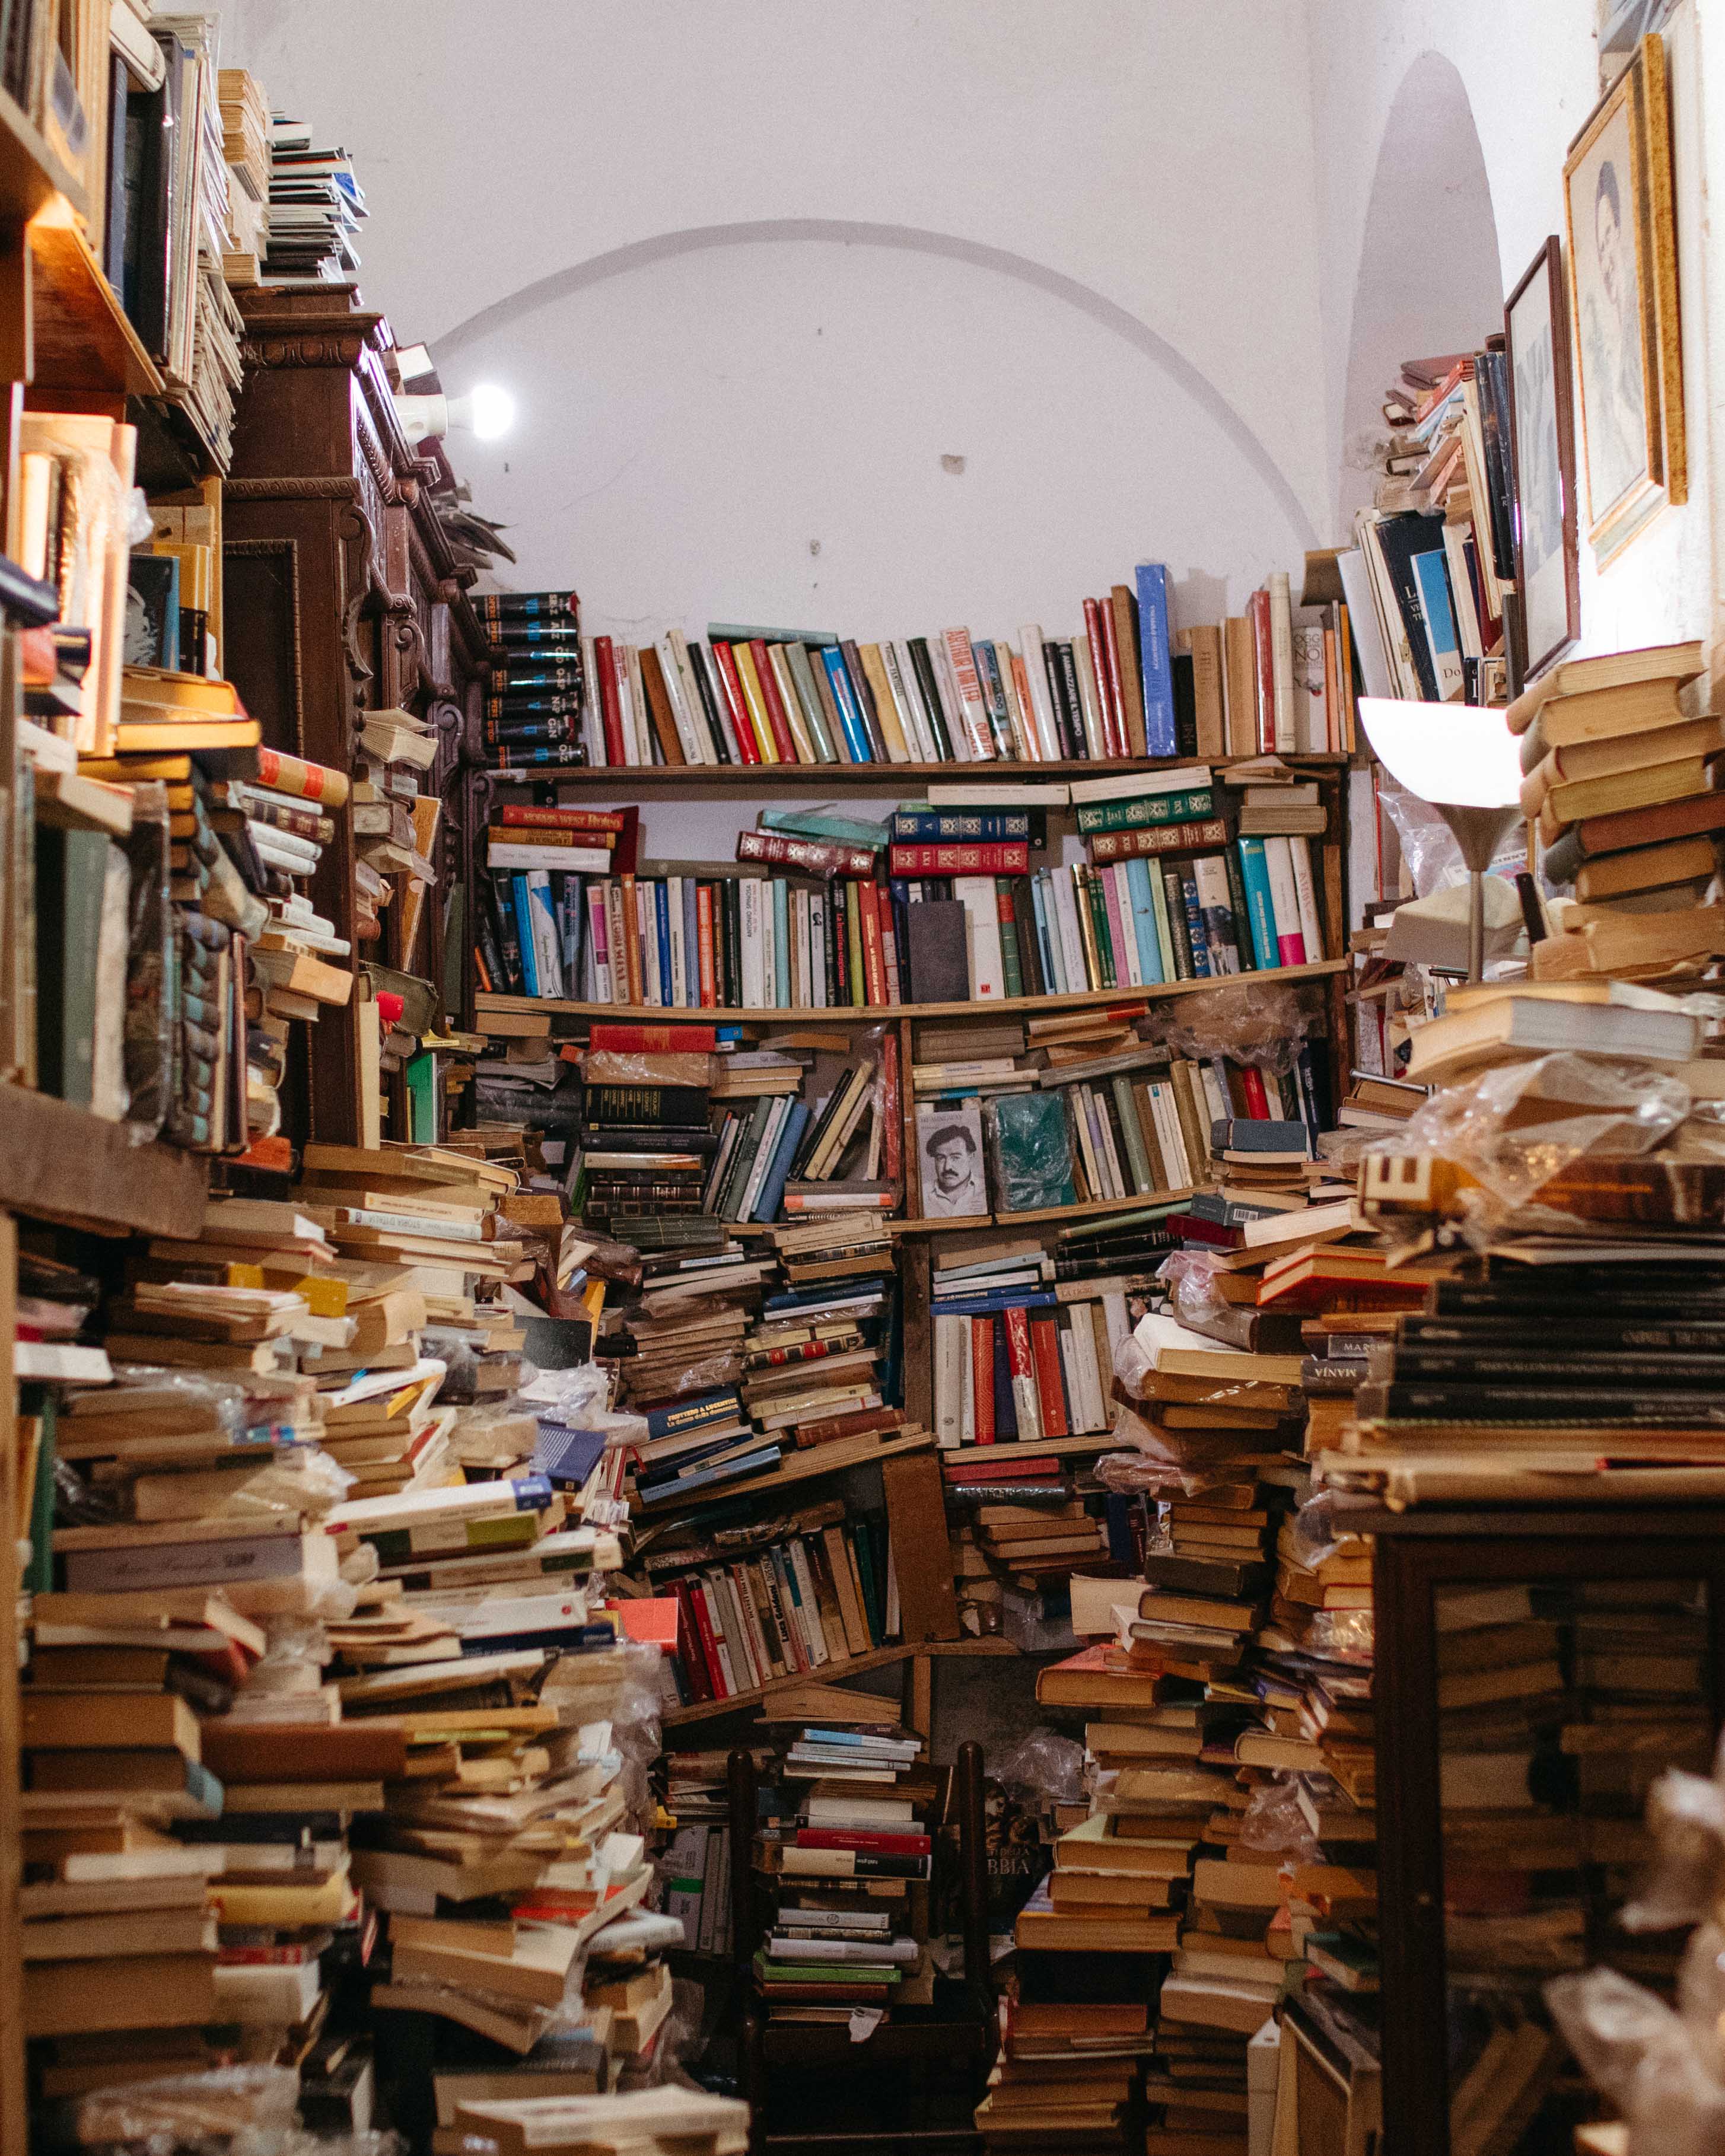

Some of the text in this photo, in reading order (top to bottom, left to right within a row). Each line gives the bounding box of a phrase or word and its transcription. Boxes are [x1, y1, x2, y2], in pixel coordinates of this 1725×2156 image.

[488, 595, 497, 619] OPERE
[946, 630, 981, 702] ARTHUR MILLER
[1062, 655, 1077, 701] AMMAZZARE
[1071, 710, 1083, 737] TEMPO
[1344, 1343, 1382, 1353] MARR
[769, 1585, 784, 1620] Goldoni
[778, 1620, 790, 1642] Luca
